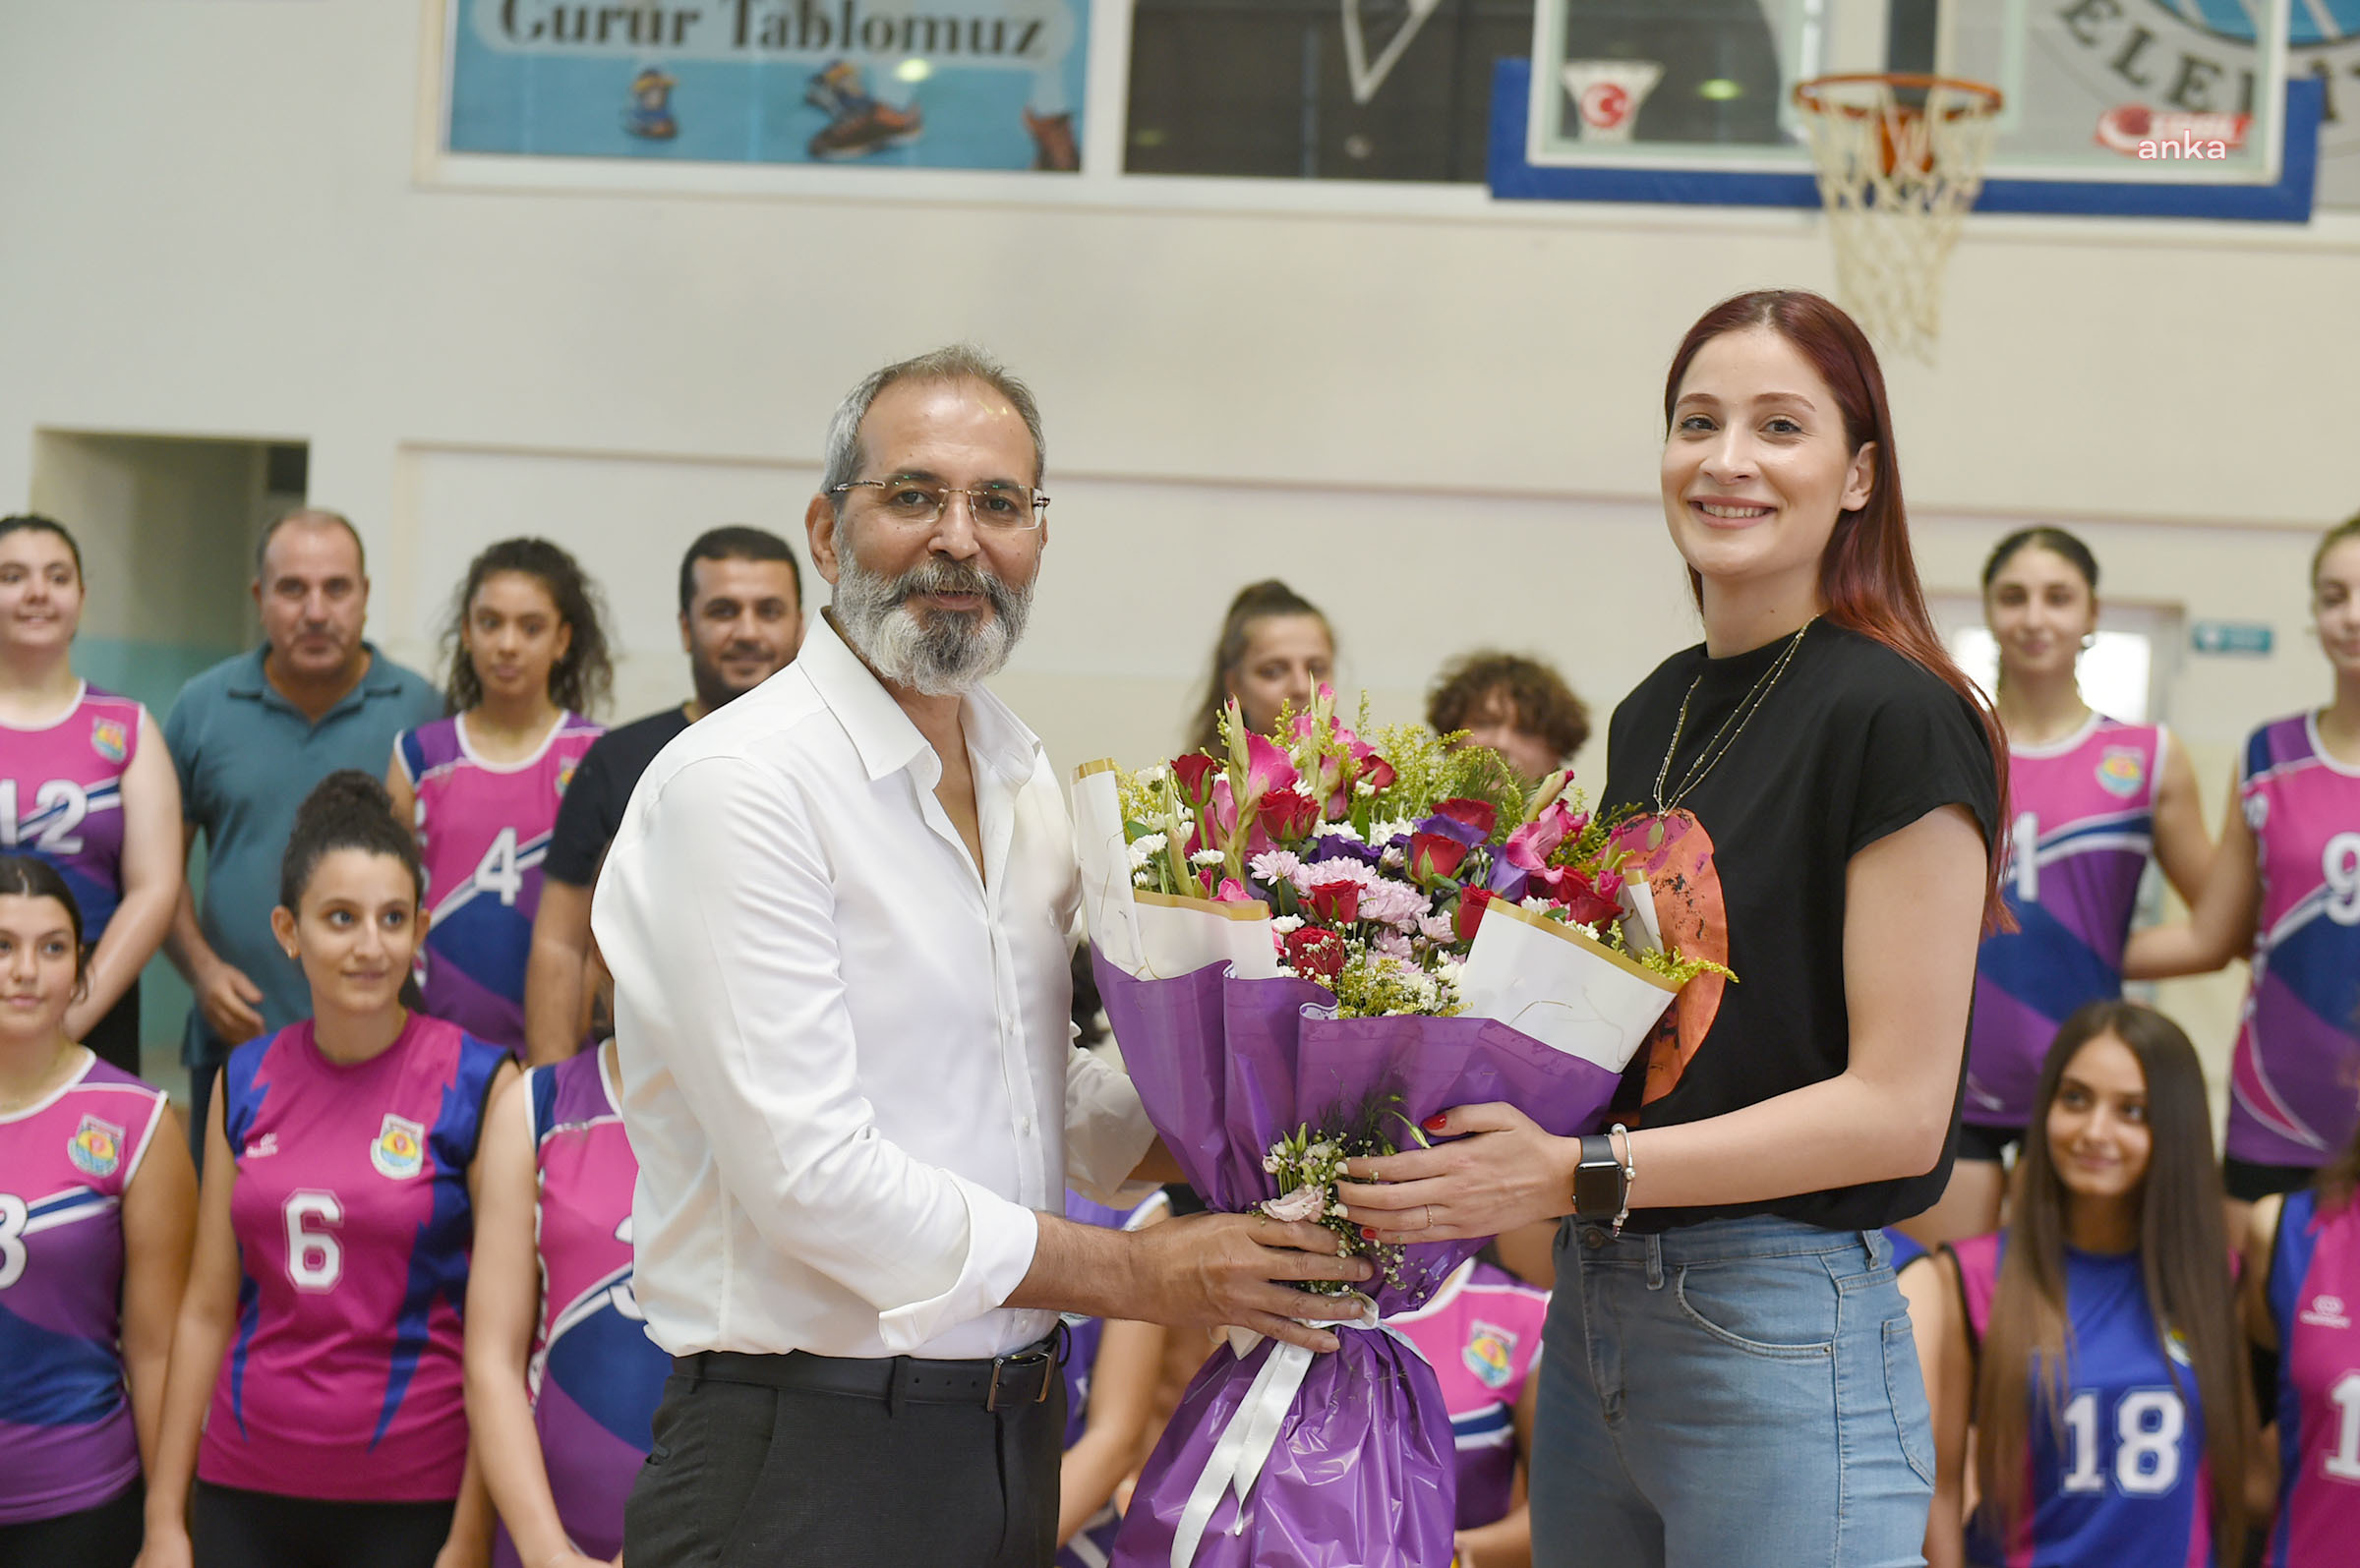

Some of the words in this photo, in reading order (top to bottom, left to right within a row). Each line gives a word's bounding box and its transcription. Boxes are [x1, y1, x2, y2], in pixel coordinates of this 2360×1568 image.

[717, 0, 1046, 55] Tablomuz
[0, 778, 88, 854] 12
[475, 826, 523, 906] 4
[2322, 831, 2360, 926] 9
[283, 1189, 343, 1293] 6
[2062, 1388, 2186, 1496] 18
